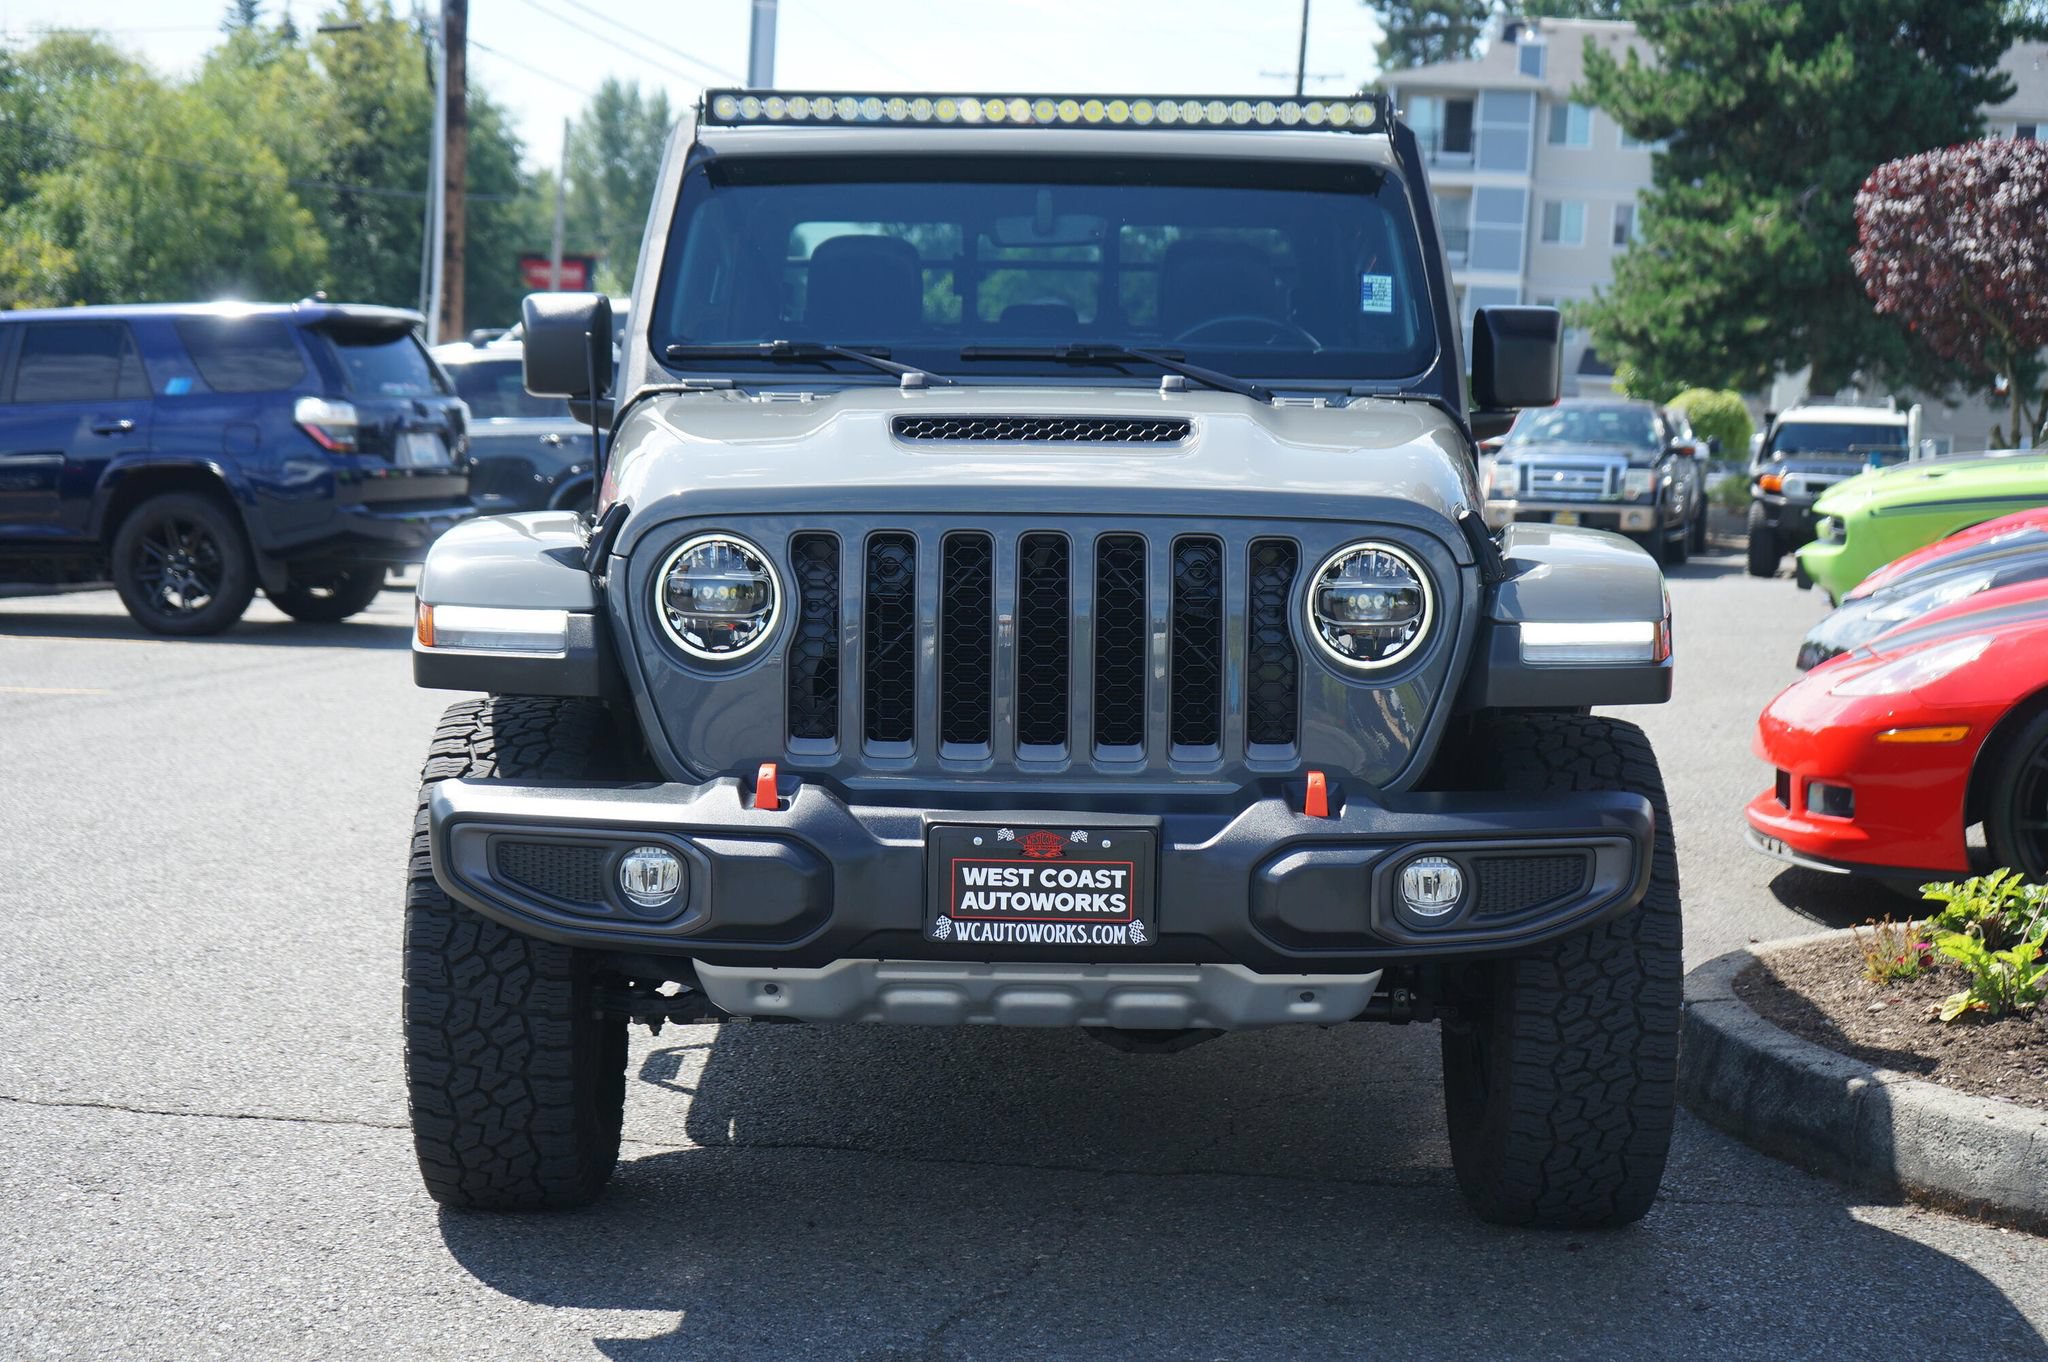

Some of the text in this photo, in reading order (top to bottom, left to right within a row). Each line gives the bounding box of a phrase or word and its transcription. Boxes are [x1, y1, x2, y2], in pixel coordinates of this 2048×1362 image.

[962, 867, 1127, 889] WEST COAST
[960, 891, 1127, 913] AUTOWORKS
[954, 922, 1127, 945] WCAUTOWORKS.COM
